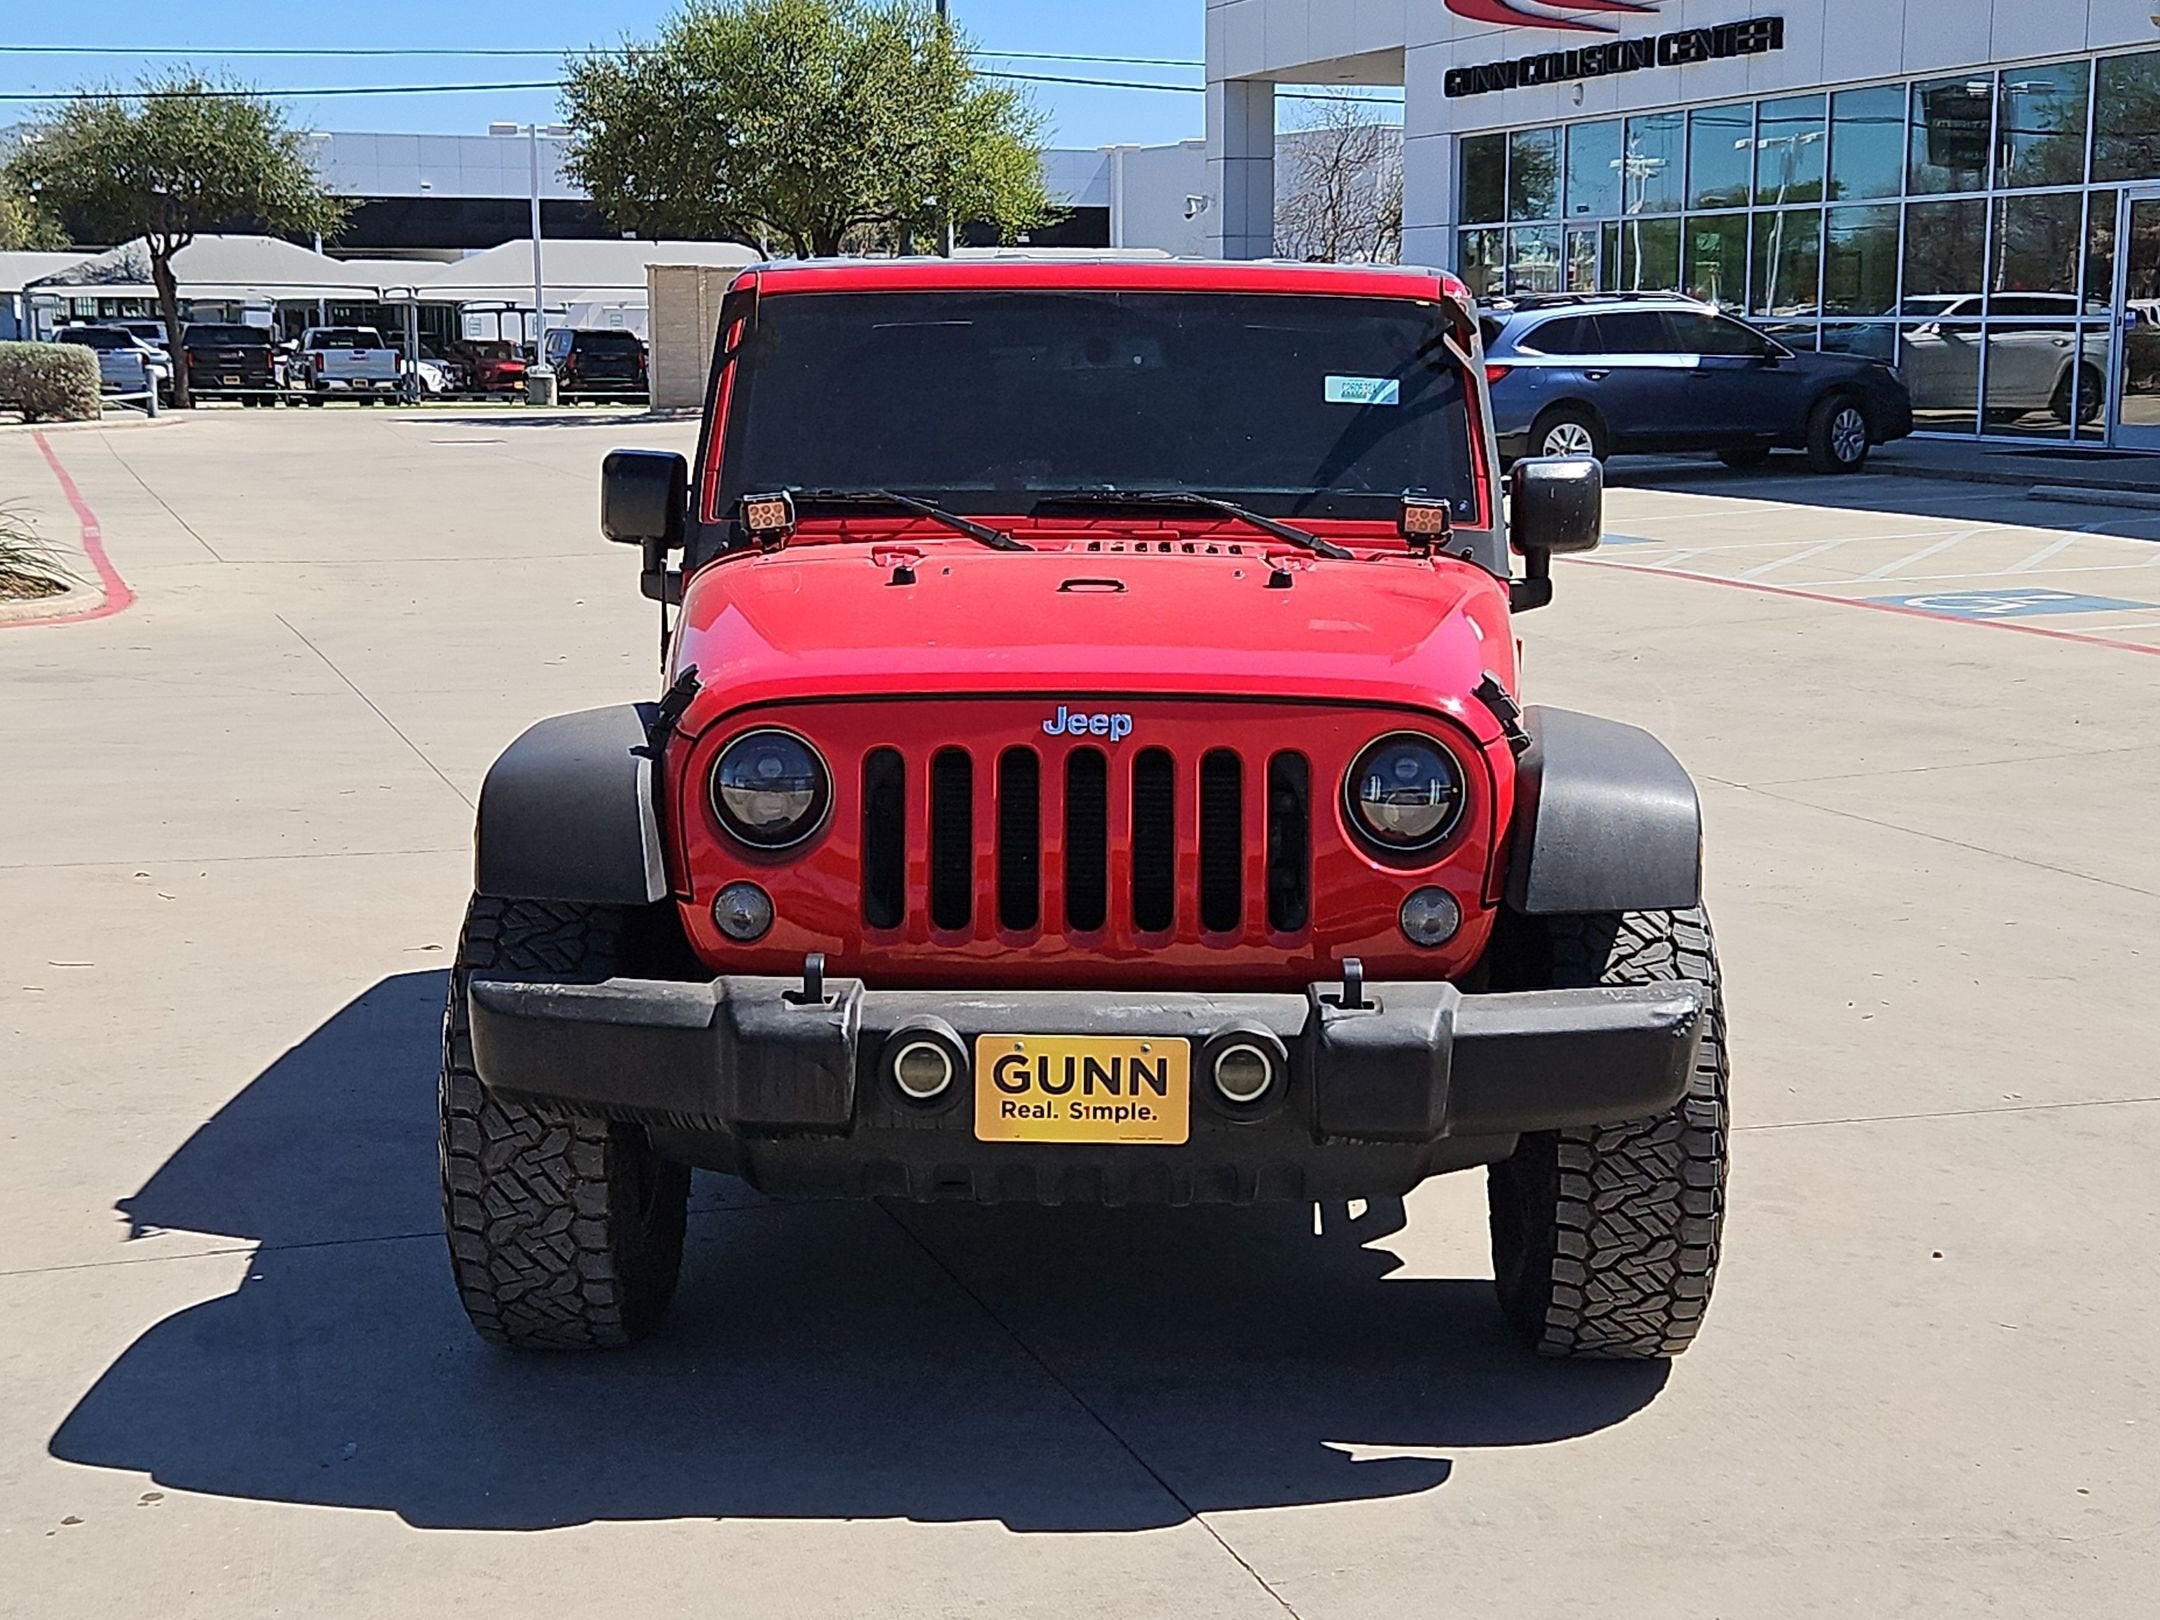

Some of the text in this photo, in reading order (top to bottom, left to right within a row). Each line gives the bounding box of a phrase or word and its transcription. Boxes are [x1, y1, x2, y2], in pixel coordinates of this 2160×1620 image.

[1444, 17, 1784, 98] GUNN COLLISION CENTER
[1043, 706, 1132, 741] Jeep
[993, 1054, 1168, 1097] GUNN
[1001, 1101, 1059, 1119] Real.
